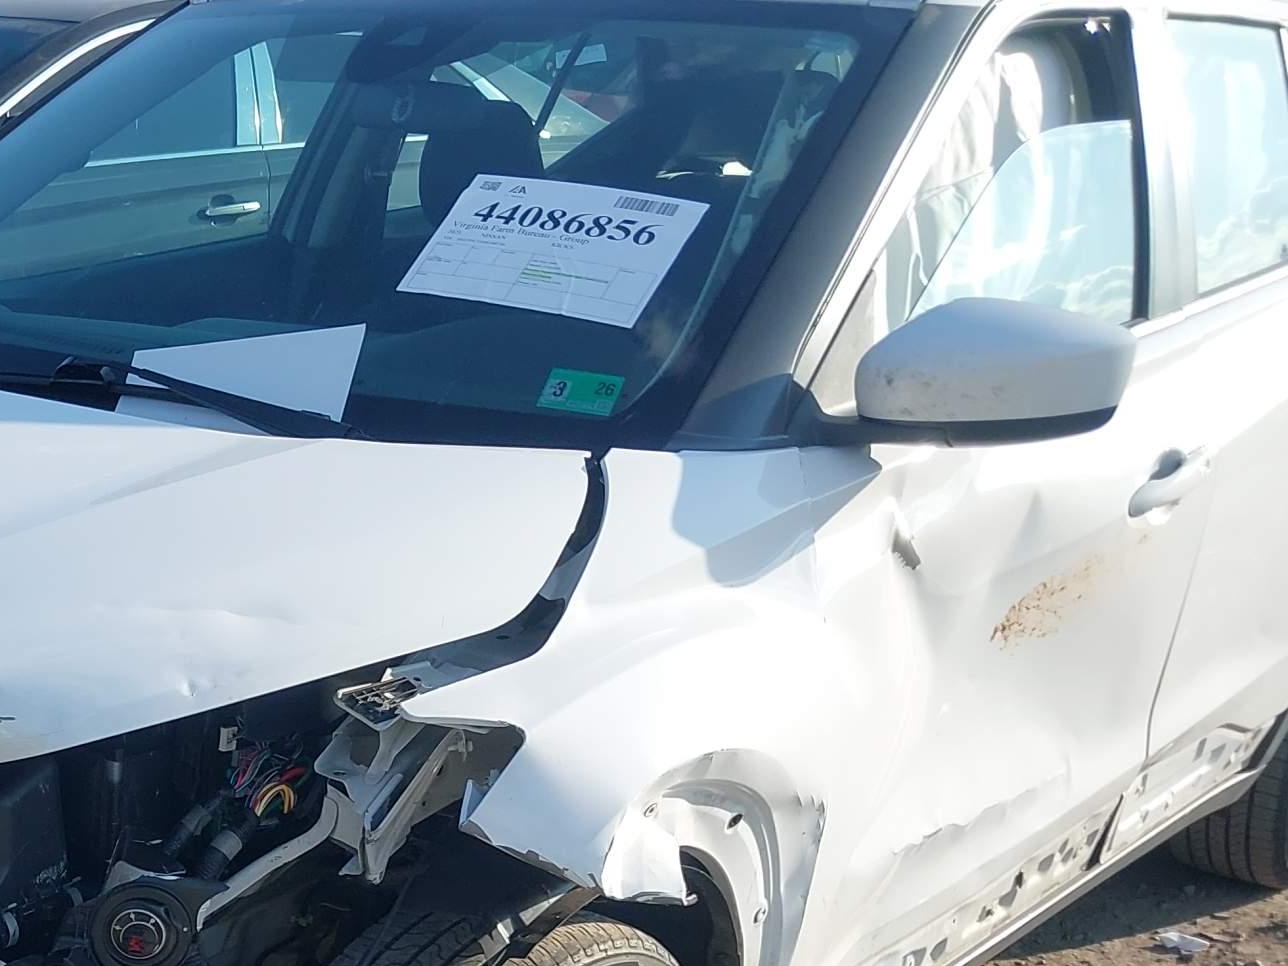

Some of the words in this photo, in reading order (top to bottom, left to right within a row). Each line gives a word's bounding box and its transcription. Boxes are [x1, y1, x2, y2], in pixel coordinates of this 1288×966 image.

[454, 220, 489, 231] Virginia
[491, 225, 515, 234] Farm
[559, 234, 590, 245] Group
[472, 201, 665, 246] 44086856
[552, 381, 568, 397] 3
[593, 382, 617, 397] 26
